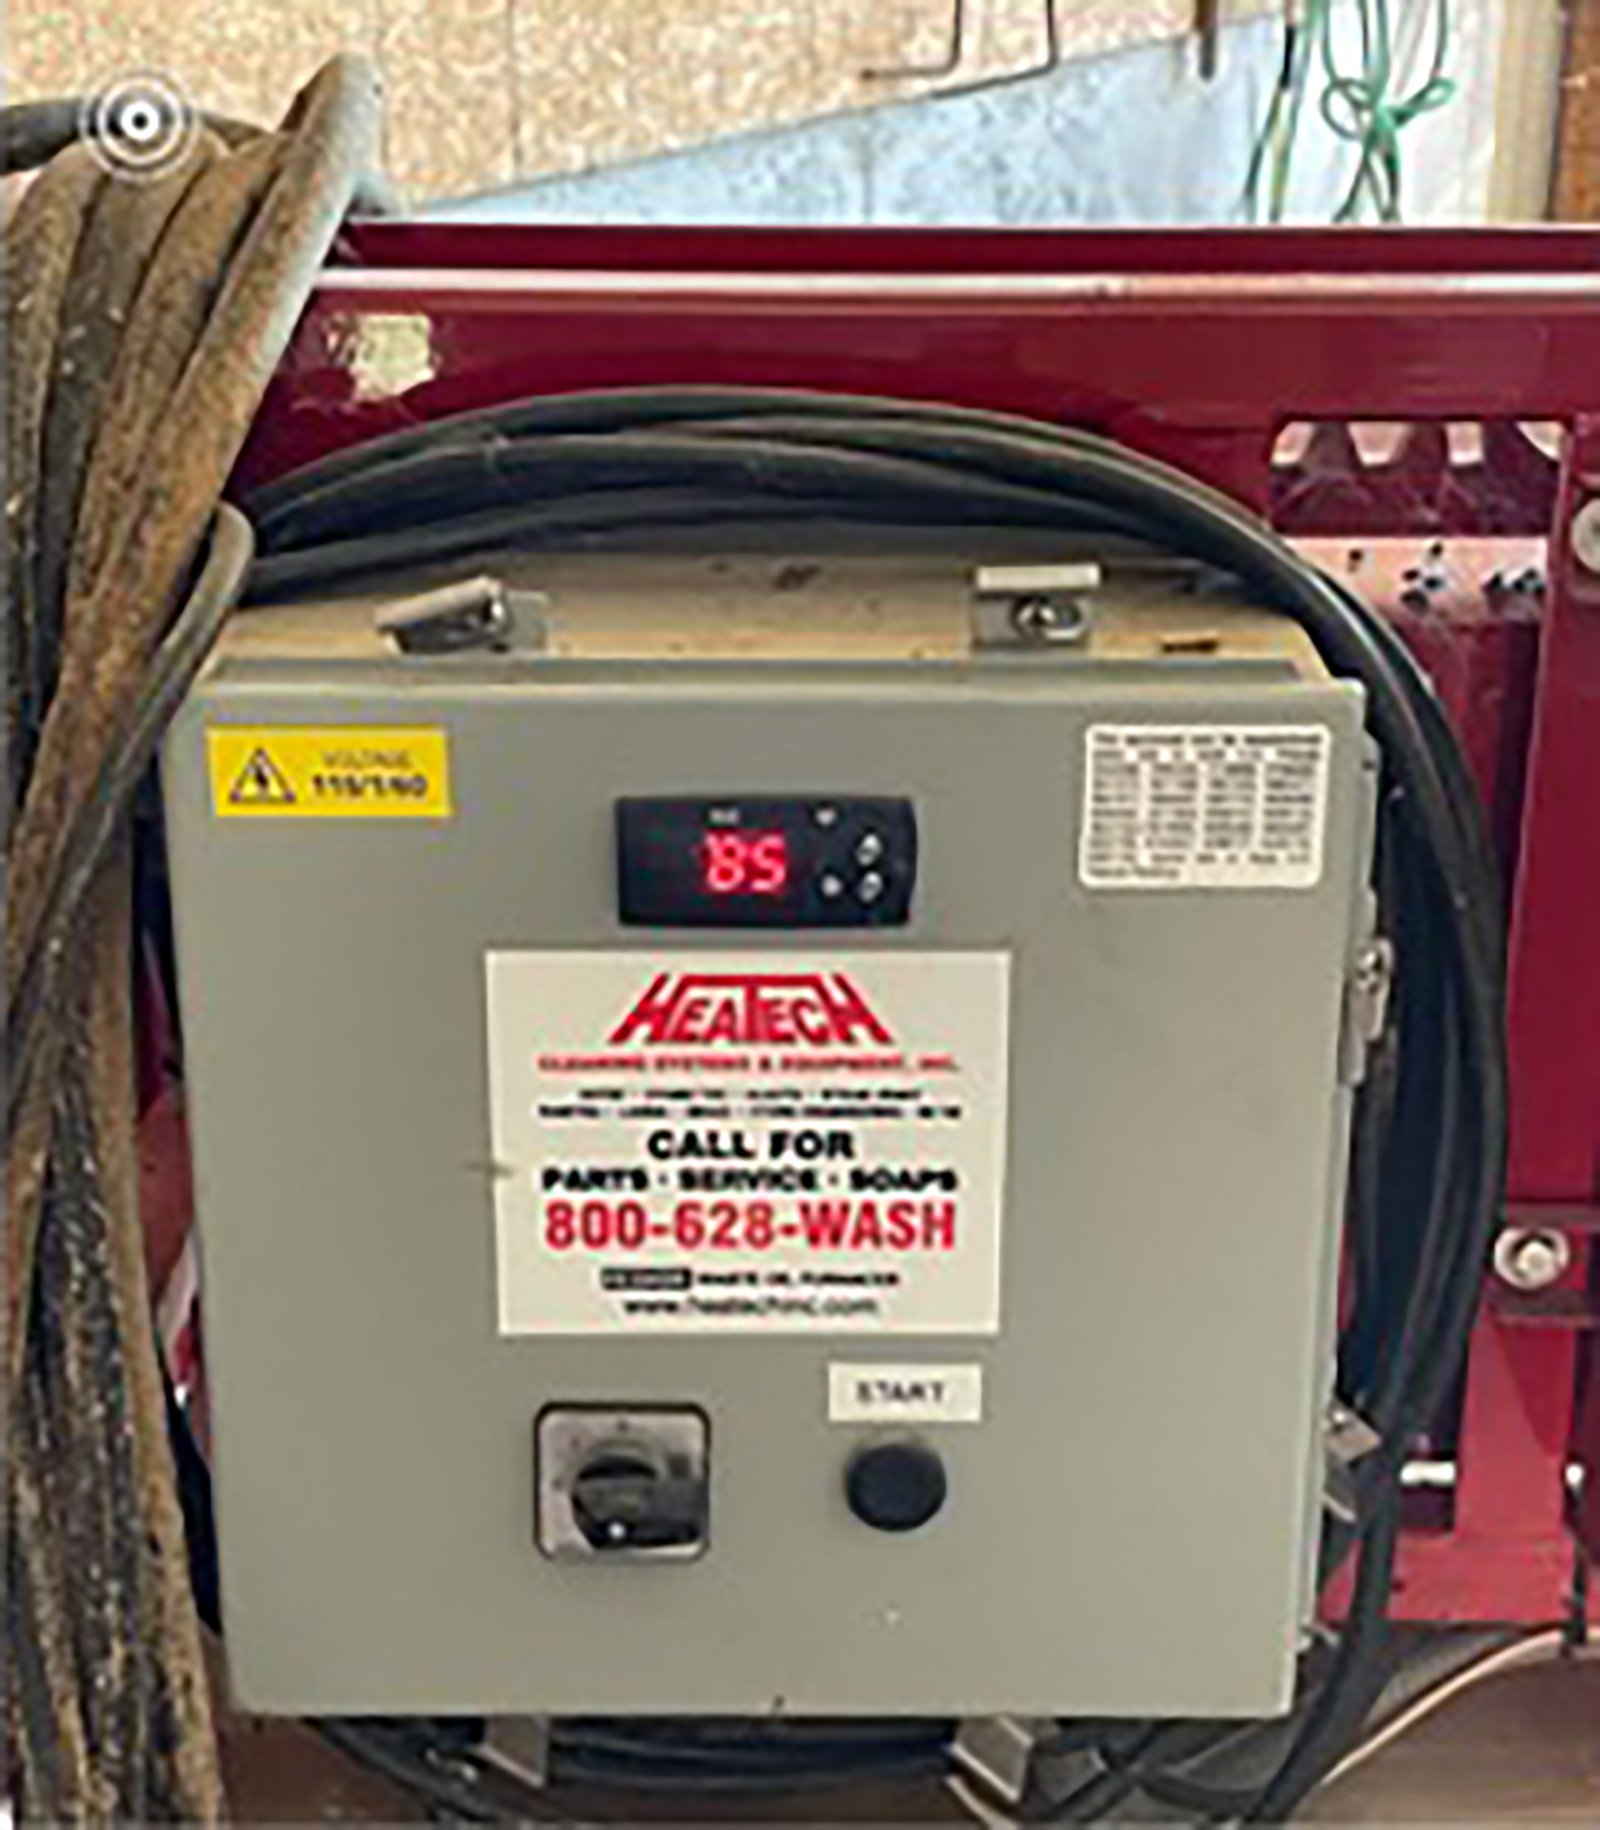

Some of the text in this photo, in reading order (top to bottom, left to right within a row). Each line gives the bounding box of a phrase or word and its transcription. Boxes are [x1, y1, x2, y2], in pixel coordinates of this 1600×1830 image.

[609, 973, 894, 1044] HEATECH
[647, 1130, 854, 1159] CALL FOR
[542, 1168, 958, 1191] PARTS SERVICE SOAPS
[544, 1200, 957, 1250] 800-628-WASH
[855, 1381, 945, 1404] START
